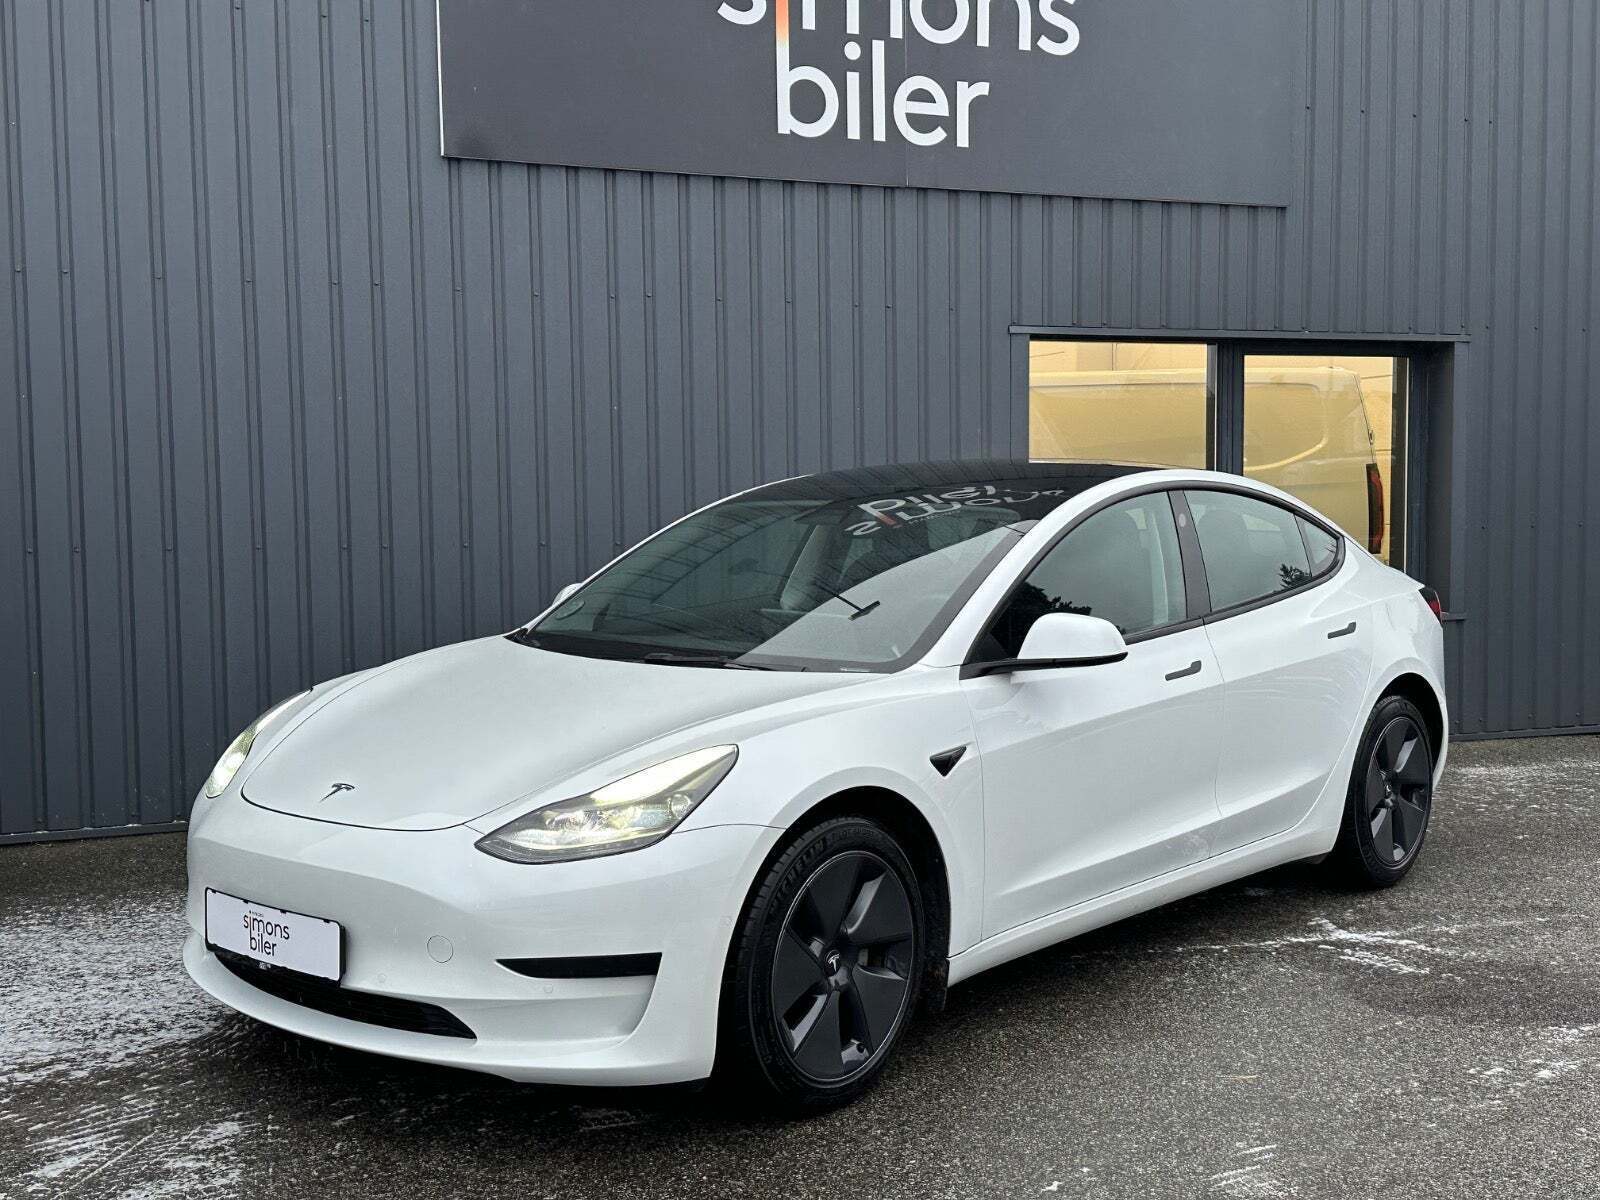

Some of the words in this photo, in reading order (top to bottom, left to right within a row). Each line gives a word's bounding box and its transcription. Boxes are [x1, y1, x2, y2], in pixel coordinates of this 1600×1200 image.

[776, 37, 990, 148] biler
[243, 911, 291, 940] simons
[249, 930, 277, 956] biler
